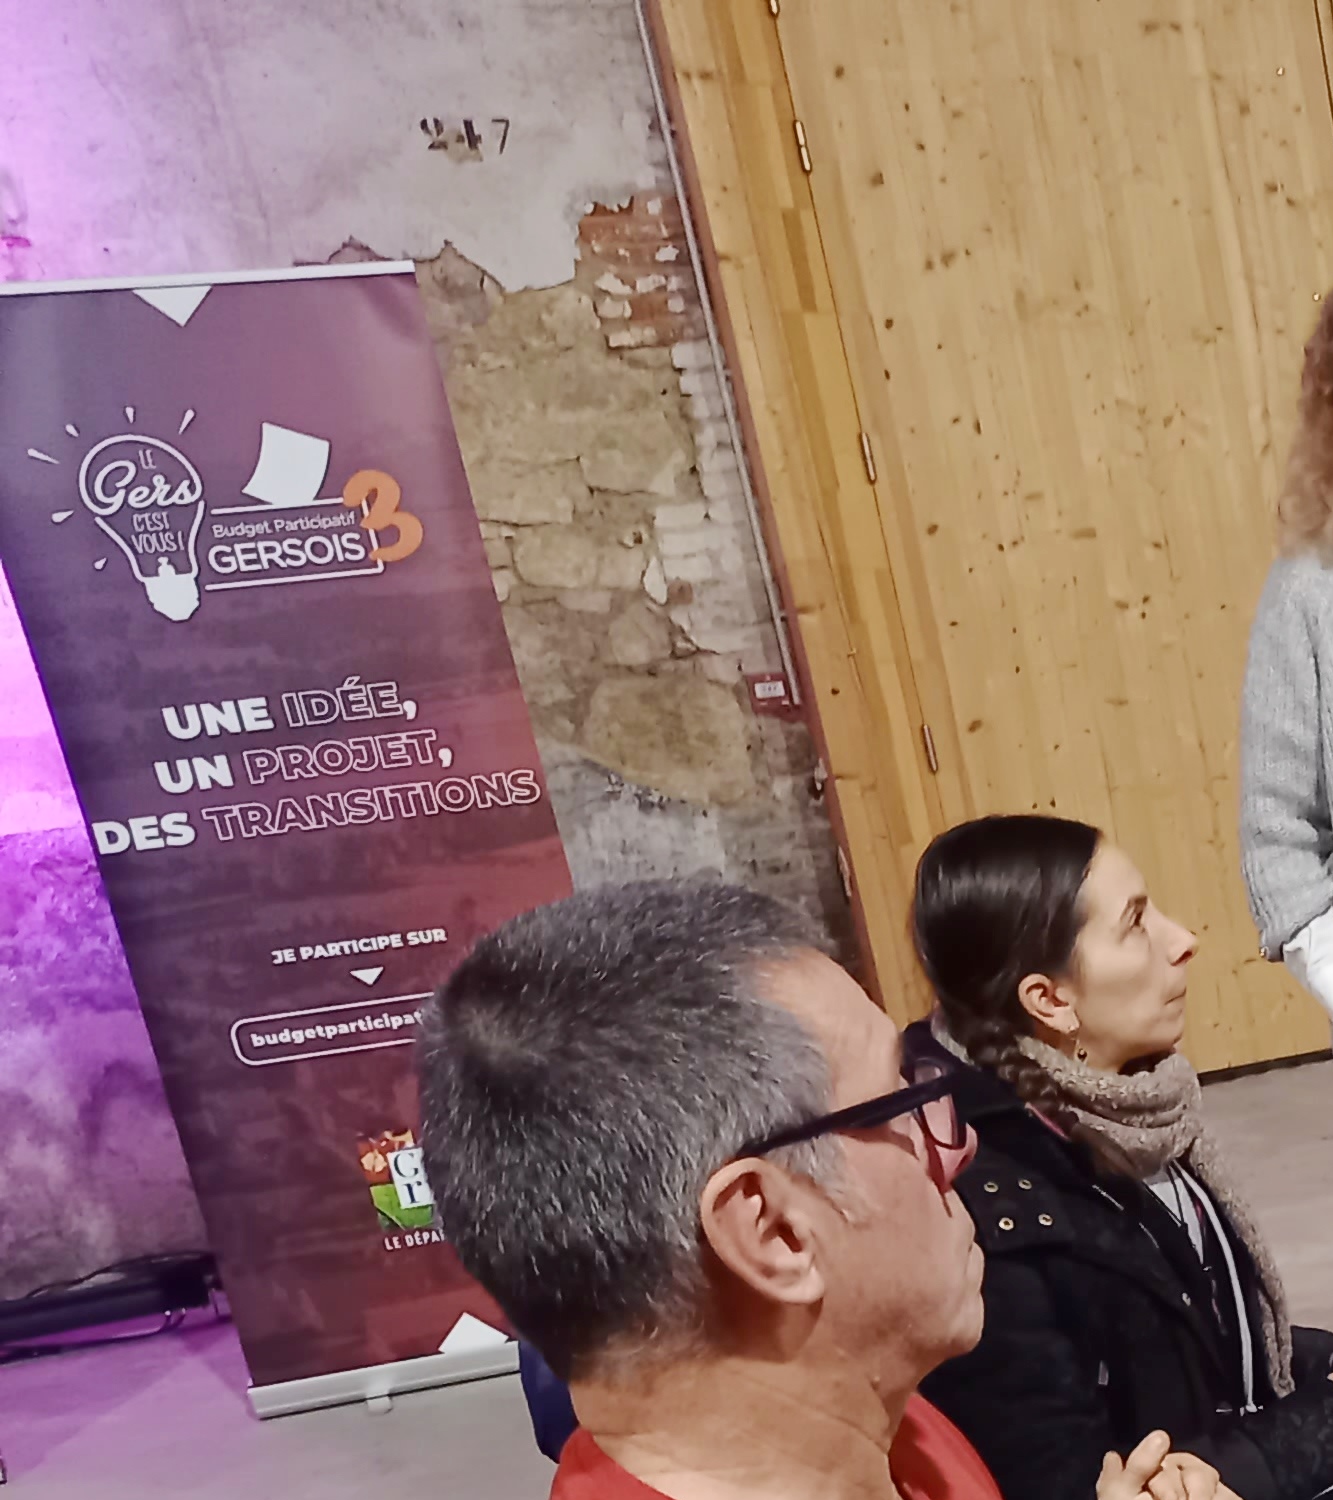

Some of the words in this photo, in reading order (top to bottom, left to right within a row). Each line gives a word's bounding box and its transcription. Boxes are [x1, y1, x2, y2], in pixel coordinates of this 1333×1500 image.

[138, 449, 157, 470] LE
[94, 460, 192, 516] Gers
[132, 511, 170, 532] C'EST
[208, 532, 366, 574] GERSOIS
[342, 469, 424, 562] 3
[211, 521, 273, 539] Budget
[273, 510, 356, 532] Participatif
[161, 696, 275, 740] UNE
[281, 676, 418, 729] IDÉE,
[153, 754, 234, 794] UN
[242, 729, 454, 785] PROJET,
[92, 811, 196, 855] DES
[202, 769, 541, 841] TRANSITIONS
[271, 948, 297, 965] JE
[299, 934, 403, 961] PARTICIPE
[406, 928, 448, 946] SUR
[384, 1236, 402, 1251] LE
